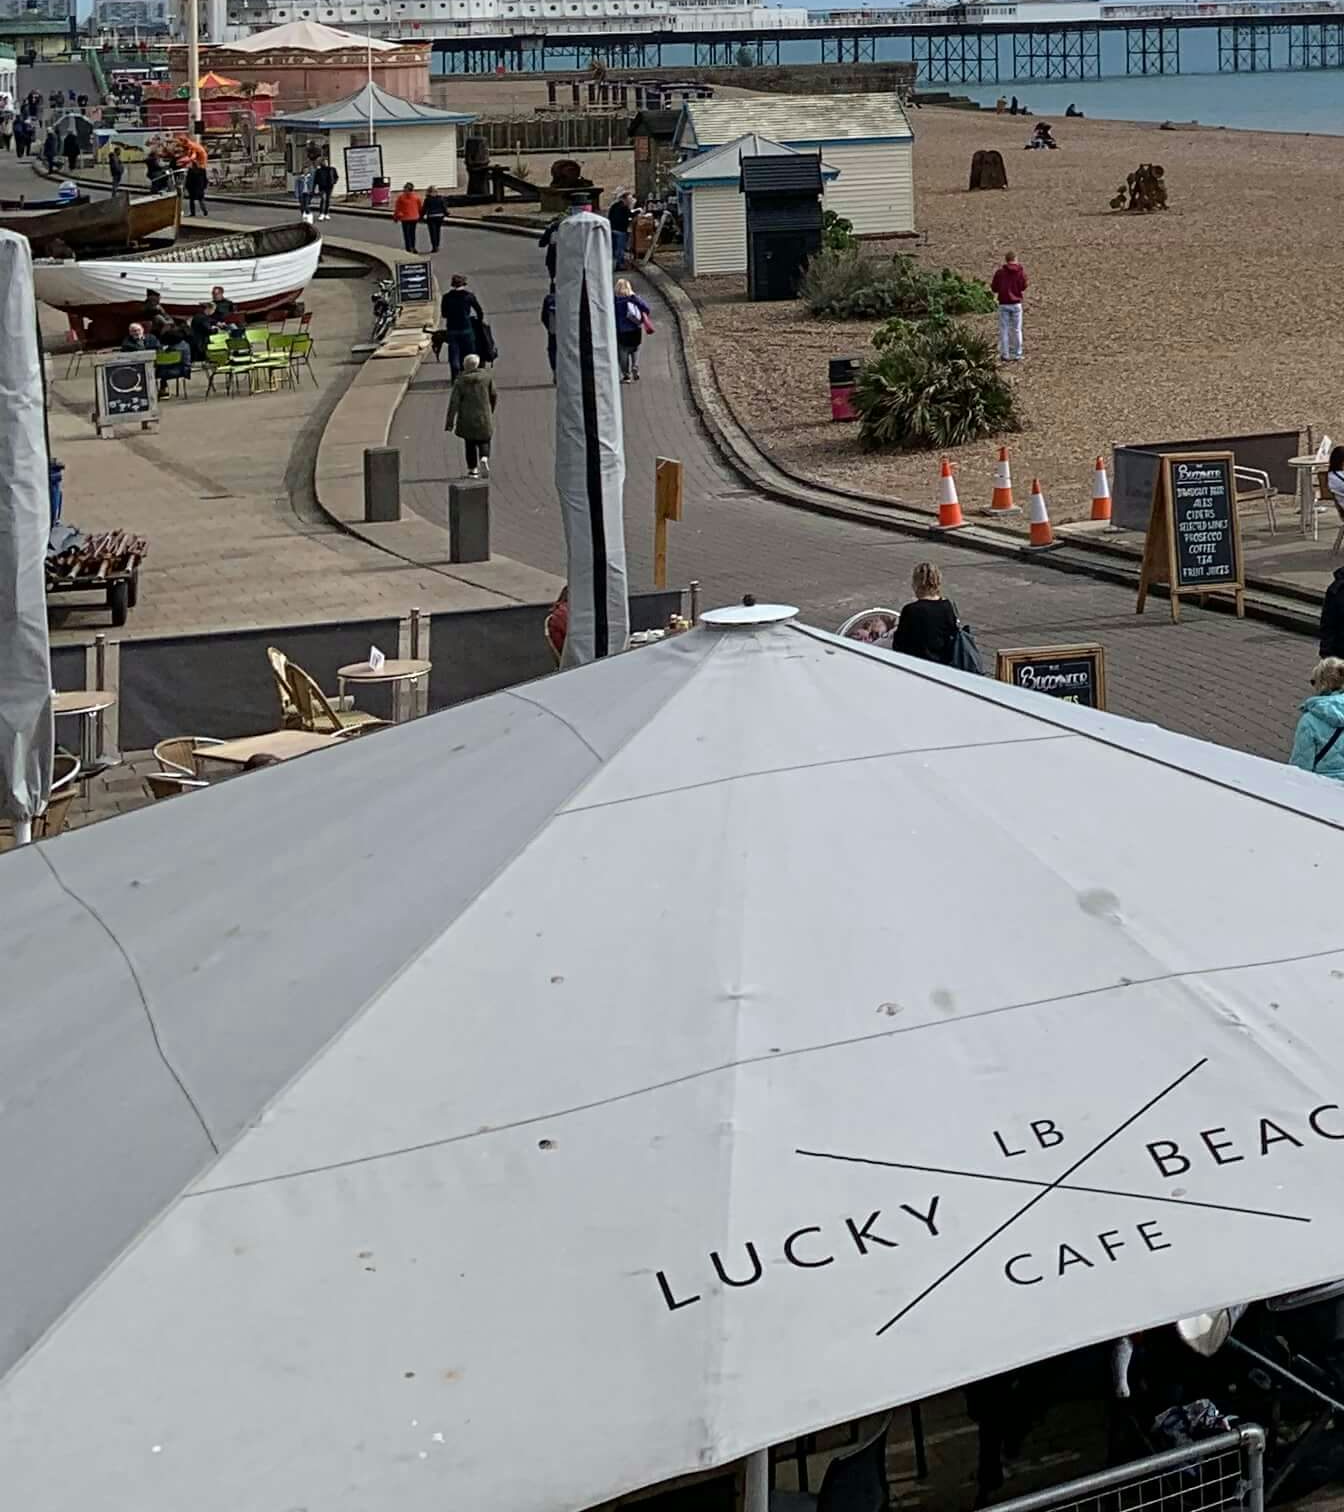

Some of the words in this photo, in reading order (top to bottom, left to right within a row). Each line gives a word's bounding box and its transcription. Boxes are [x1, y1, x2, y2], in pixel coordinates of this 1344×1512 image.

[1183, 531, 1222, 542] PROSECCO
[1188, 543, 1216, 554] COFFEE
[1196, 554, 1213, 565] TEA
[1182, 567, 1204, 577] FRUIT
[993, 1119, 1065, 1158] LB
[655, 1195, 942, 1311] LUCKY
[1004, 1220, 1172, 1286] CAFE
